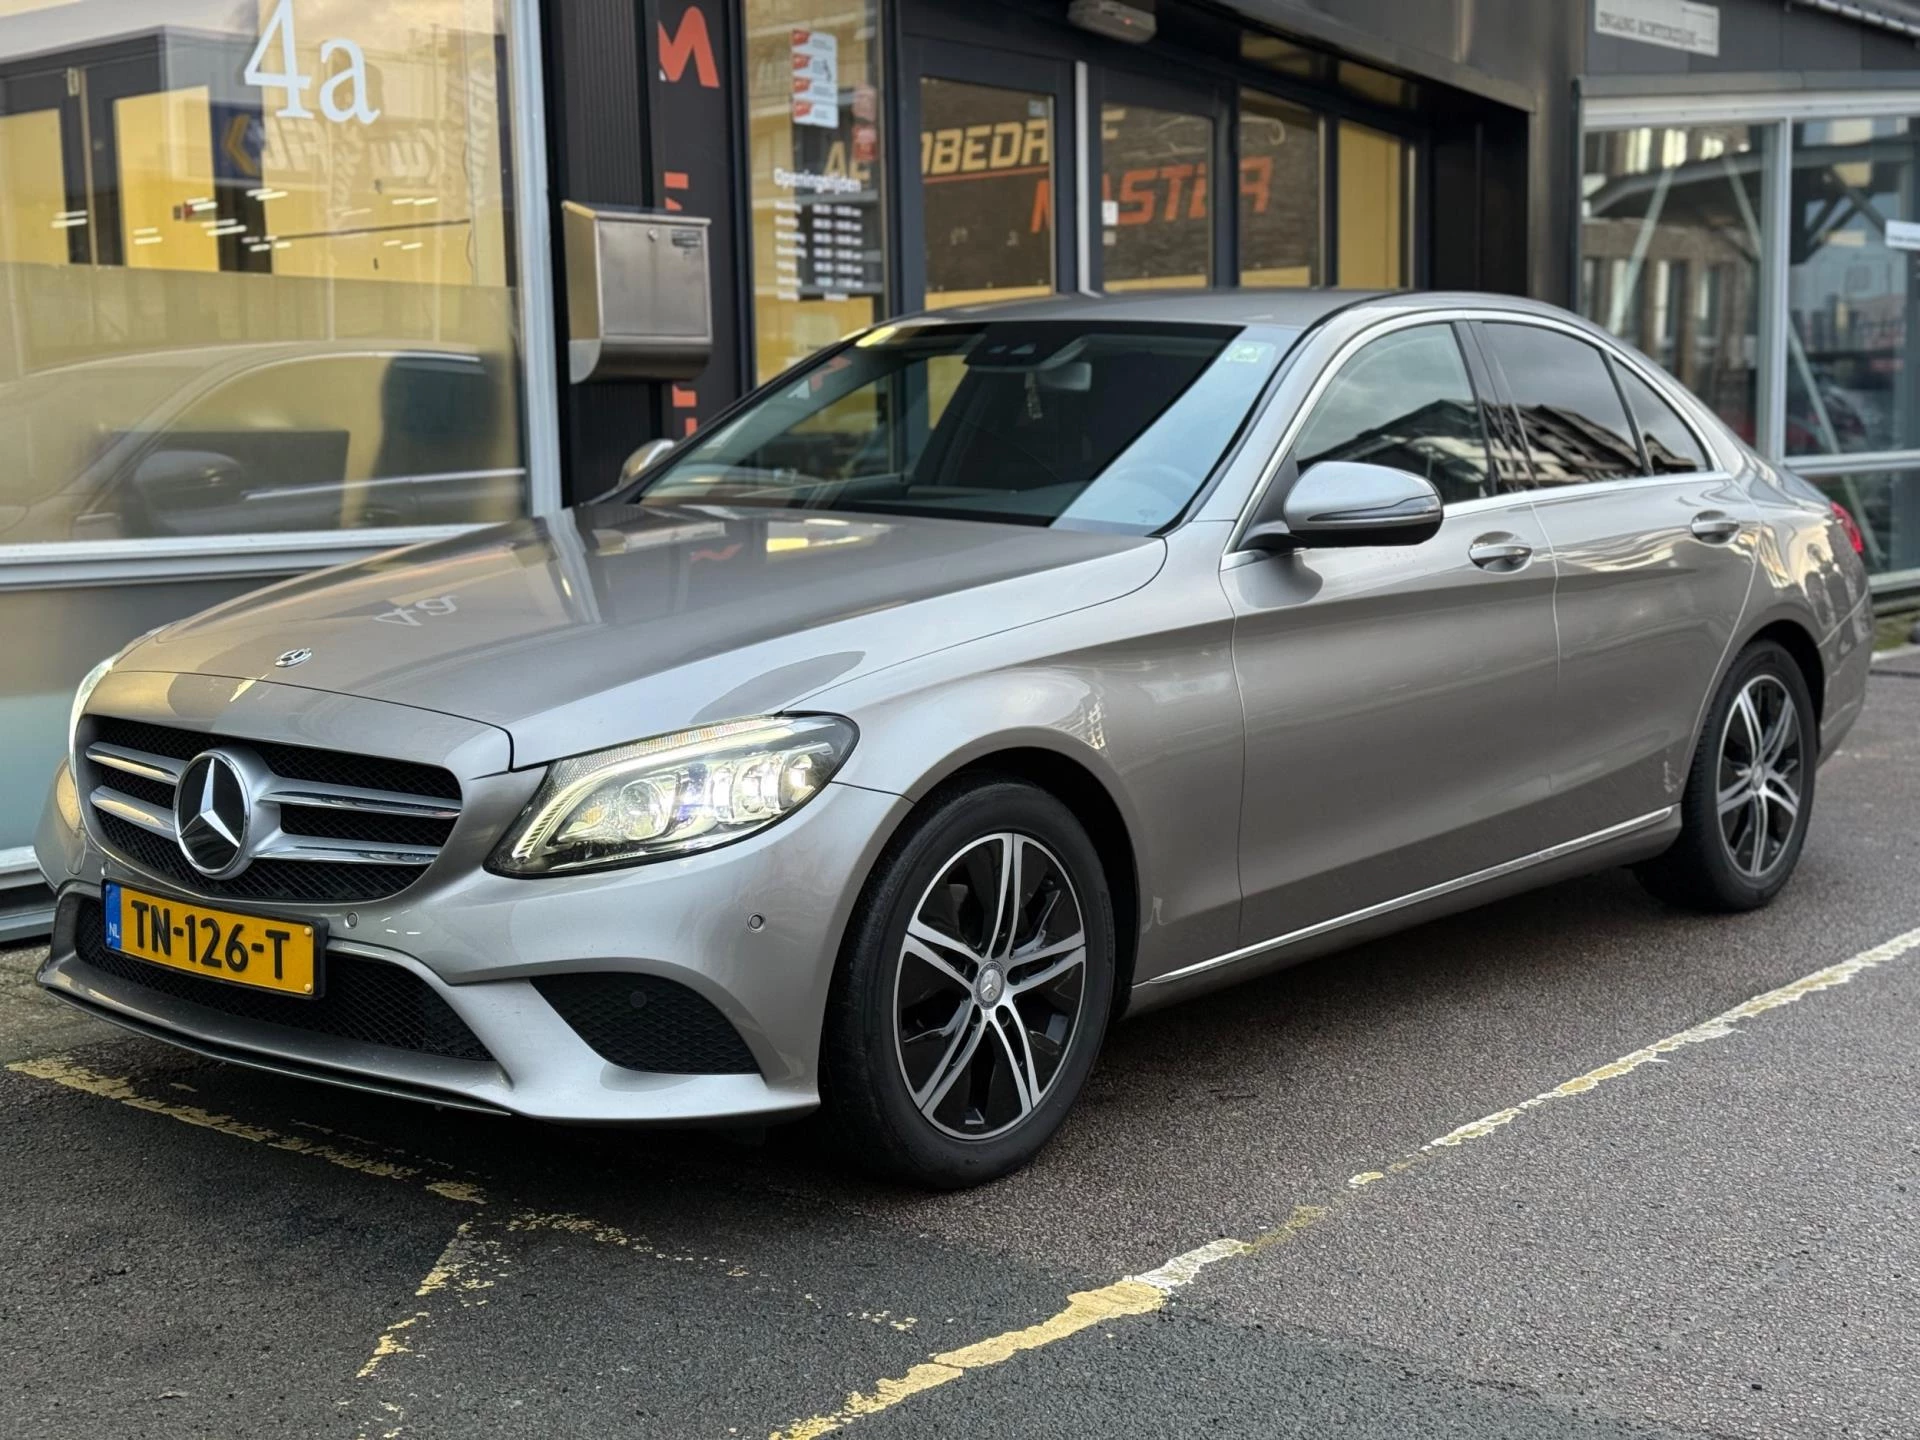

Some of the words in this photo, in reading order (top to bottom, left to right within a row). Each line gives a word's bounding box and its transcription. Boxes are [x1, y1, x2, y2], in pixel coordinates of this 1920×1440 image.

[244, 0, 381, 125] 4a
[108, 921, 121, 940] NL
[131, 899, 291, 981] TN-126-T
